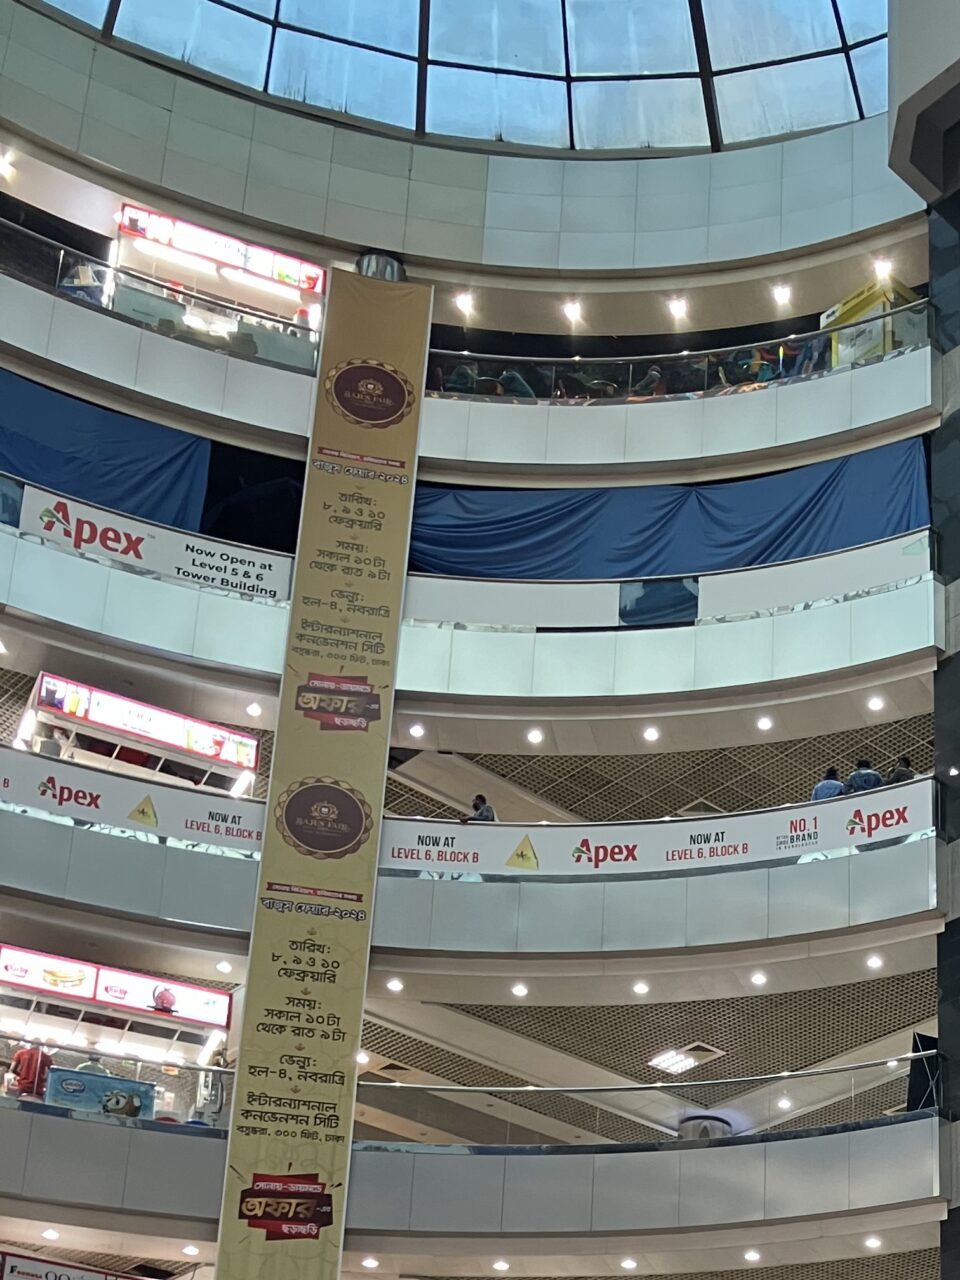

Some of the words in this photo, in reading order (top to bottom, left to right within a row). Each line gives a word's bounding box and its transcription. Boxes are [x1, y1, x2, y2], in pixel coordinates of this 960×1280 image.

[40, 501, 145, 560] Apex
[185, 544, 214, 559] Now
[219, 553, 256, 569] Open
[259, 561, 273, 571] at
[316, 549, 350, 564] সকাল
[191, 558, 227, 574] Level
[231, 567, 239, 577] 5
[242, 569, 251, 579] &
[256, 573, 264, 582] 6
[309, 560, 337, 573] থেকে
[341, 565, 364, 577] রাত
[175, 567, 216, 584] Tower
[220, 578, 277, 599] Building
[347, 604, 390, 618] নবরাত্রি
[296, 633, 357, 651] কনভেনশন
[362, 641, 385, 654] সিটি
[298, 693, 363, 714] অফার
[3, 778, 9, 788] B
[38, 776, 101, 809] Apex
[208, 811, 230, 824] NOW
[231, 815, 242, 825] AT
[296, 817, 325, 828] BAJUS
[327, 820, 349, 832] FAIR
[790, 818, 810, 833] NO.
[813, 816, 817, 829] 1
[846, 806, 908, 838] Apex
[185, 820, 212, 833] LEVEL
[225, 827, 254, 840] BLOCK
[256, 830, 262, 840] B
[790, 832, 818, 843] BRAND
[417, 835, 441, 847] NOW
[443, 837, 456, 848] AT
[690, 833, 711, 846] NOW
[713, 832, 726, 843] AT
[392, 847, 422, 860] LEVEL
[437, 850, 470, 863] BLOCK
[472, 852, 479, 863] B
[572, 838, 638, 869] Apex
[666, 848, 695, 861] LEVEL
[709, 844, 740, 858] BLOCK
[742, 843, 748, 854] B
[261, 897, 292, 913] বাজুস
[289, 939, 330, 954] তারিখ:
[293, 956, 301, 965] ৯
[306, 958, 315, 967] ও
[321, 960, 340, 969] ১০
[264, 1008, 300, 1022] সকাল
[256, 1022, 286, 1035] থেকে
[291, 1025, 315, 1038] রাত
[298, 1070, 345, 1086] নবরাত্রি
[247, 1092, 337, 1113] ইন্টারন্যাশনাল
[241, 1109, 309, 1127] কনভেনশন
[314, 1114, 339, 1129] সিটি
[275, 1129, 297, 1138] ৩০০
[241, 1198, 318, 1218] অফার
